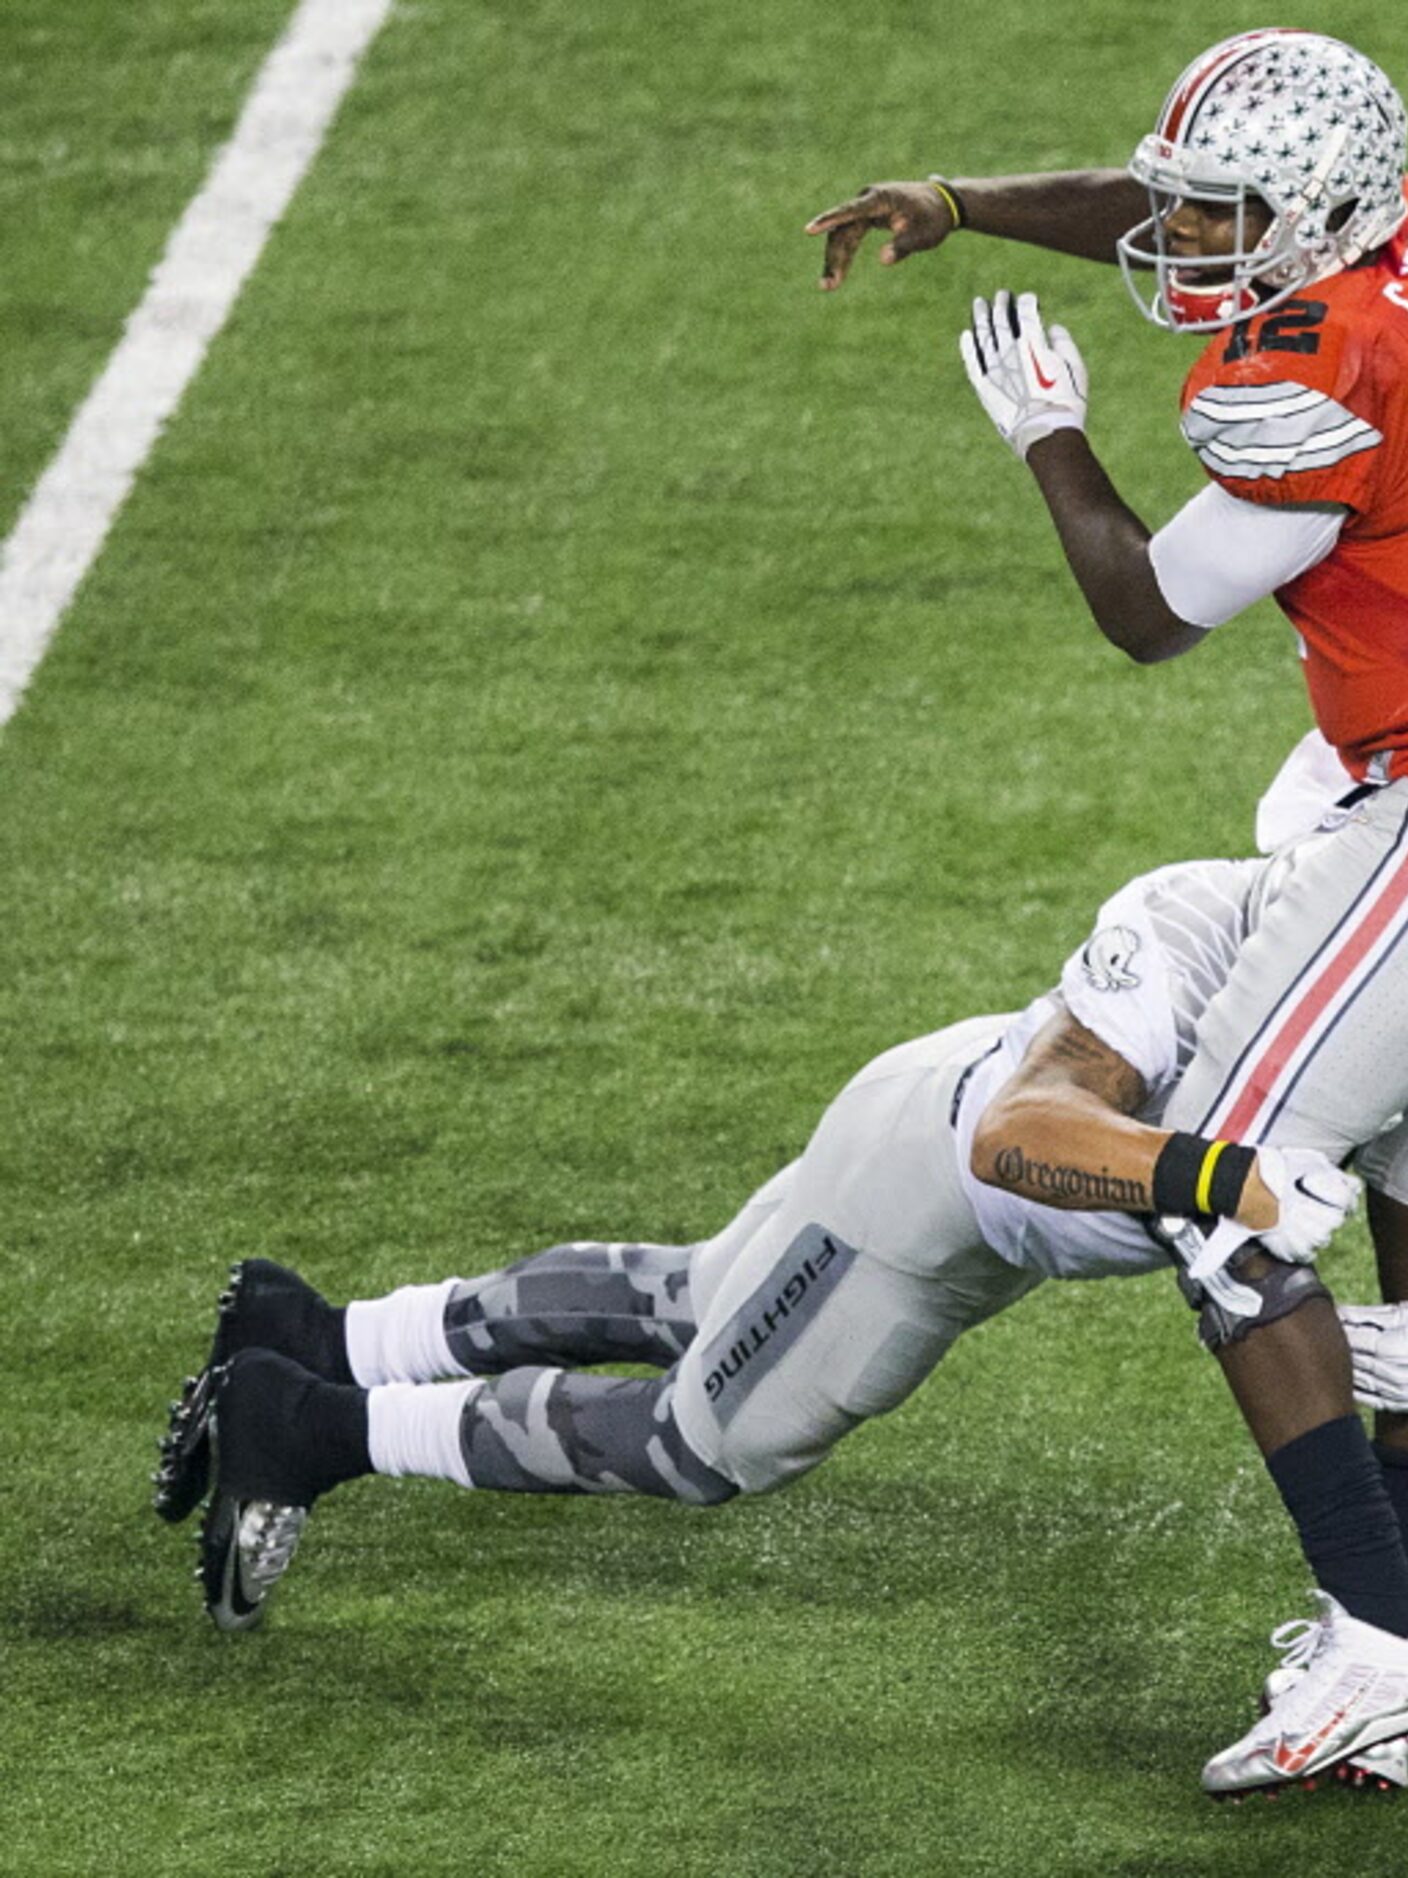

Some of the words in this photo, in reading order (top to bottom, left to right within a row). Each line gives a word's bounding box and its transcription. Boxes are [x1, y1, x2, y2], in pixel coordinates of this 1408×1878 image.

[1222, 299, 1328, 364] 12
[995, 1145, 1147, 1205] Oregonian
[702, 1236, 838, 1402] FIGHTING
